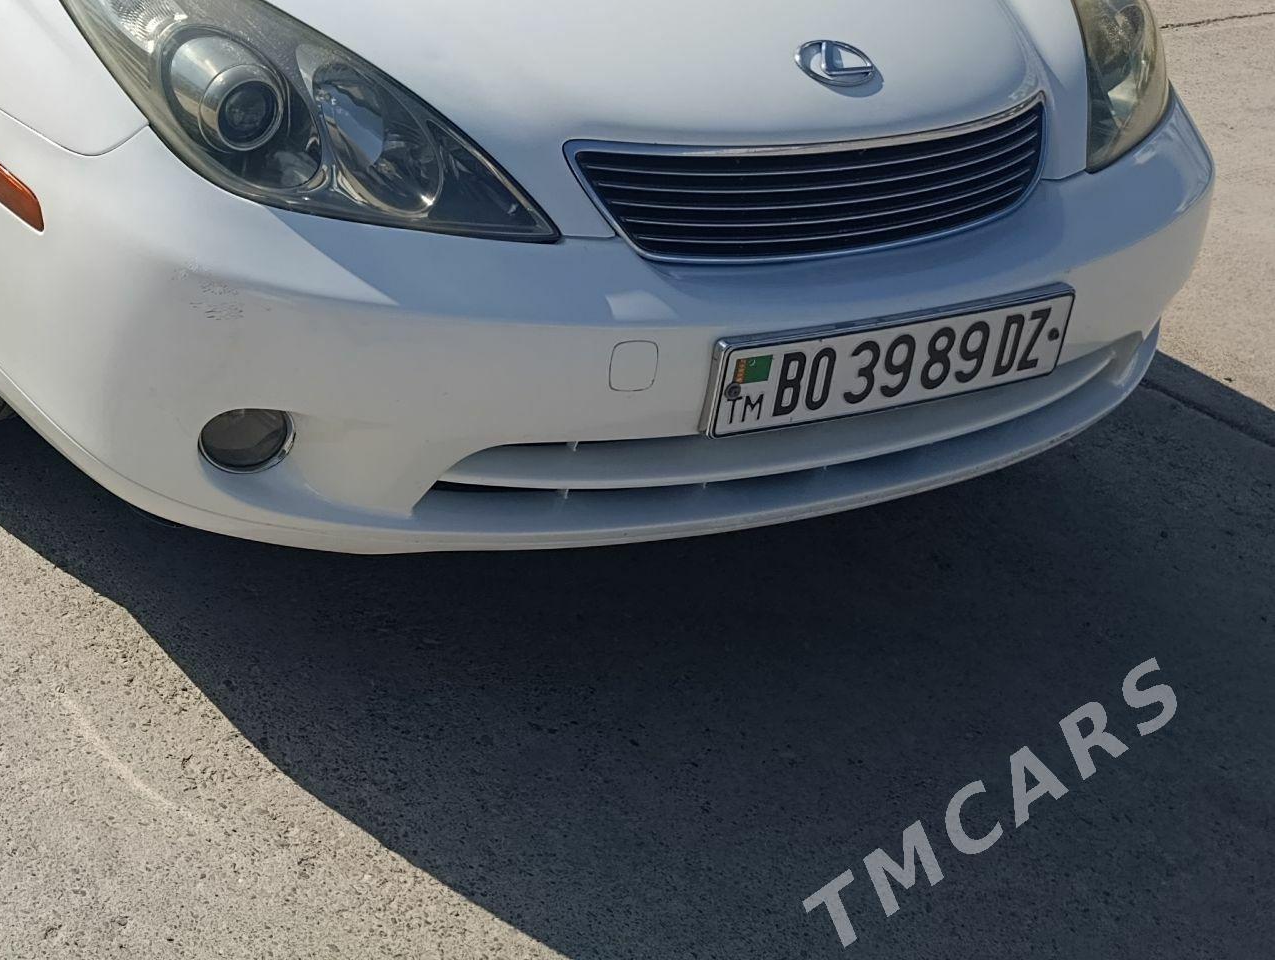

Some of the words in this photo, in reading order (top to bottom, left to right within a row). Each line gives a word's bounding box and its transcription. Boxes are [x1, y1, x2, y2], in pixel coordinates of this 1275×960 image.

[843, 320, 991, 404] 3989
[991, 306, 1052, 377] DZ
[726, 393, 764, 424] TM
